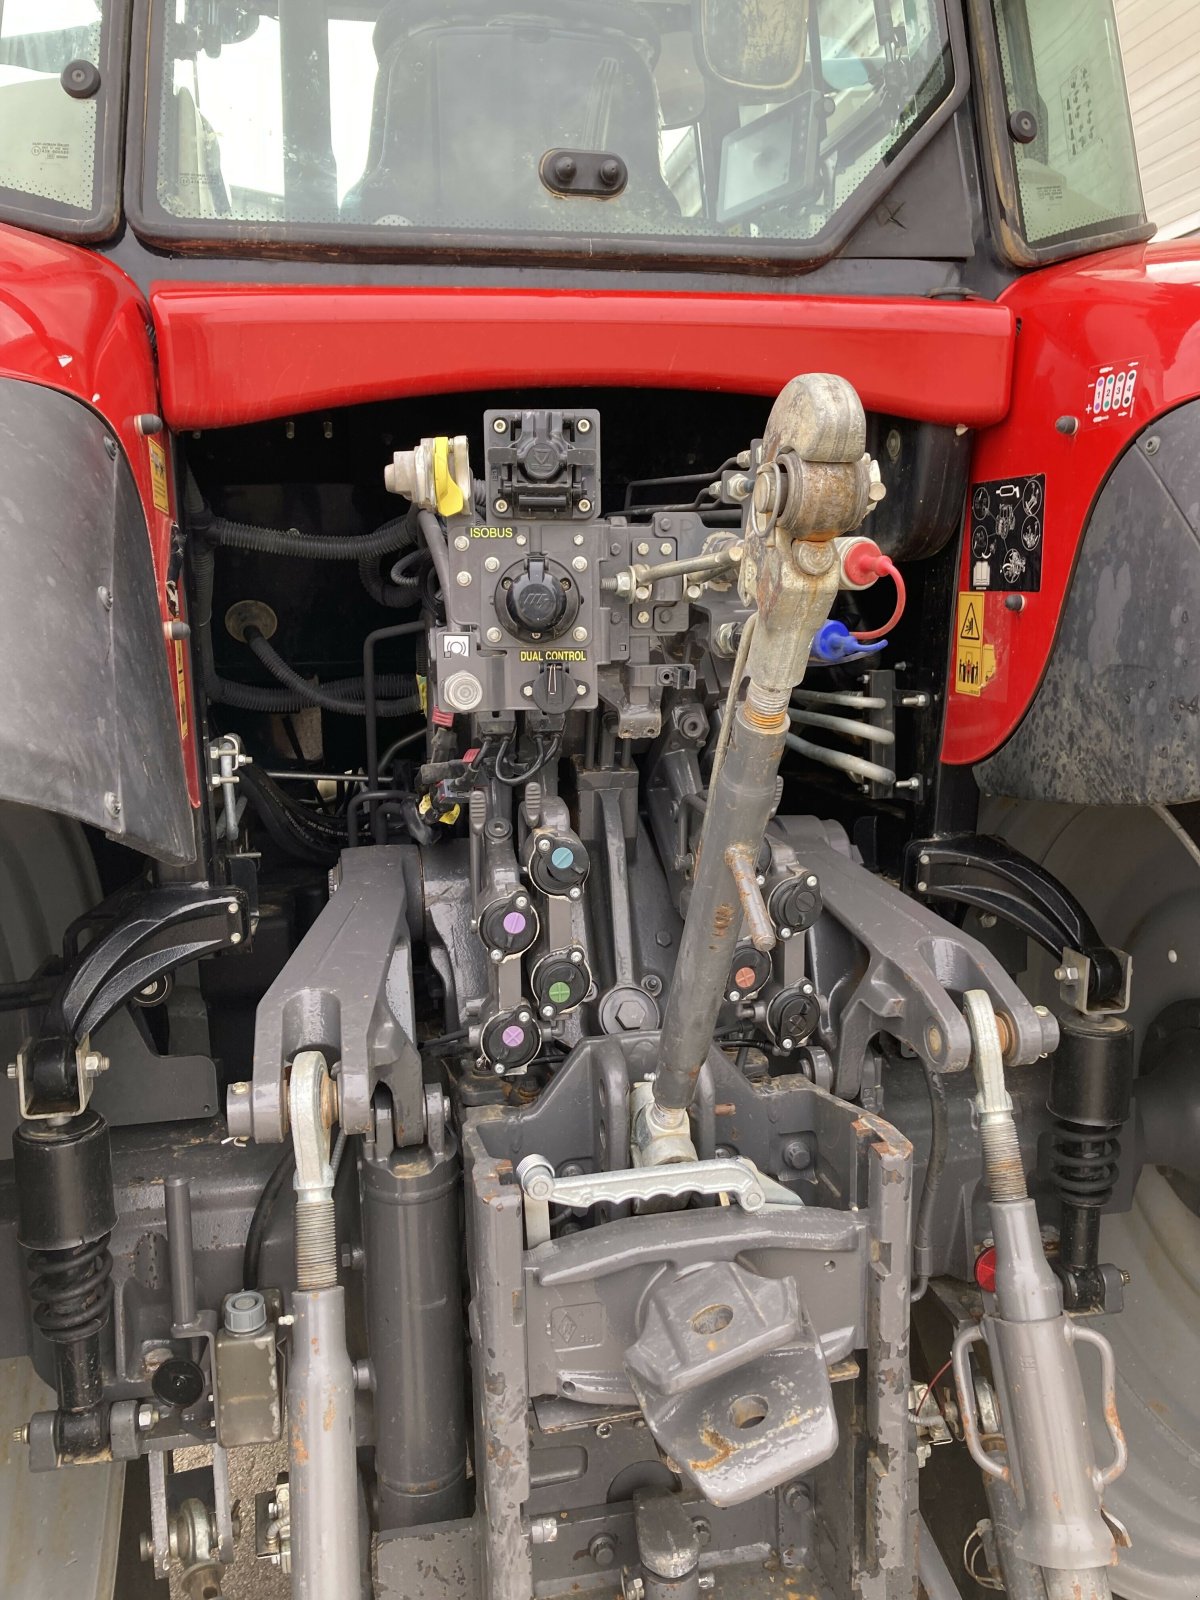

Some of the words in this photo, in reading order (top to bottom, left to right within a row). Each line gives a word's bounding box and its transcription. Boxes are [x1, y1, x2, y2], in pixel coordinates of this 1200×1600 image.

[470, 527, 513, 538] ISOBUS
[520, 651, 544, 661] DUAL
[545, 650, 587, 661] CONTROL
